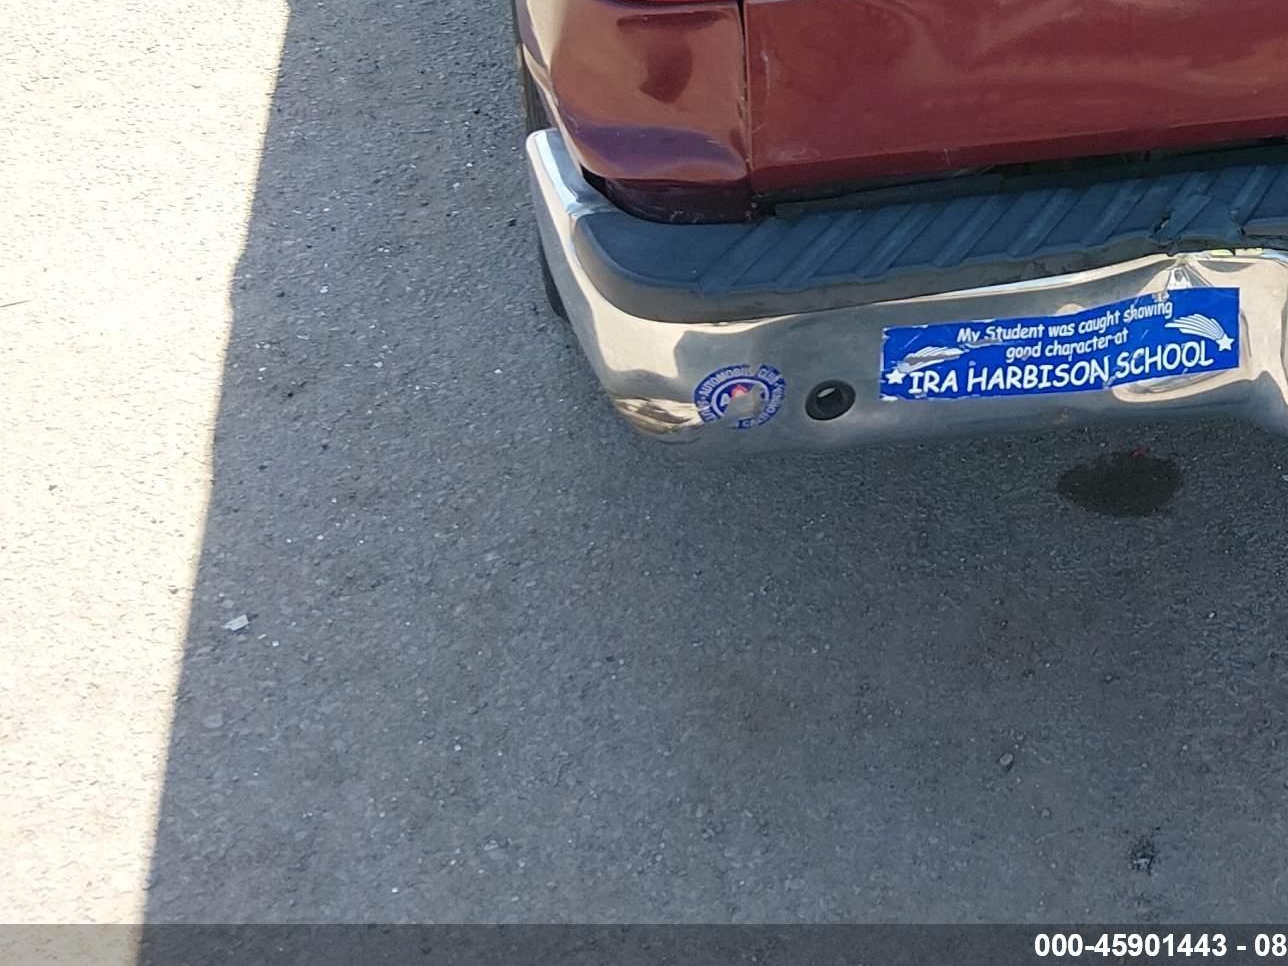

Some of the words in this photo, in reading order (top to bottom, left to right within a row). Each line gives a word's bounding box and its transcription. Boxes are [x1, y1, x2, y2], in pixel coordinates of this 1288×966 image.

[956, 327, 980, 344] My
[983, 322, 1046, 340] Student
[1047, 321, 1076, 337] was
[1078, 310, 1121, 335] caught
[1123, 300, 1173, 322] showing
[907, 370, 959, 395] IRA
[967, 356, 1110, 392] HARBISON
[1114, 339, 1215, 380] SCHOOL
[1005, 341, 1043, 364] good
[1044, 330, 1112, 361] character
